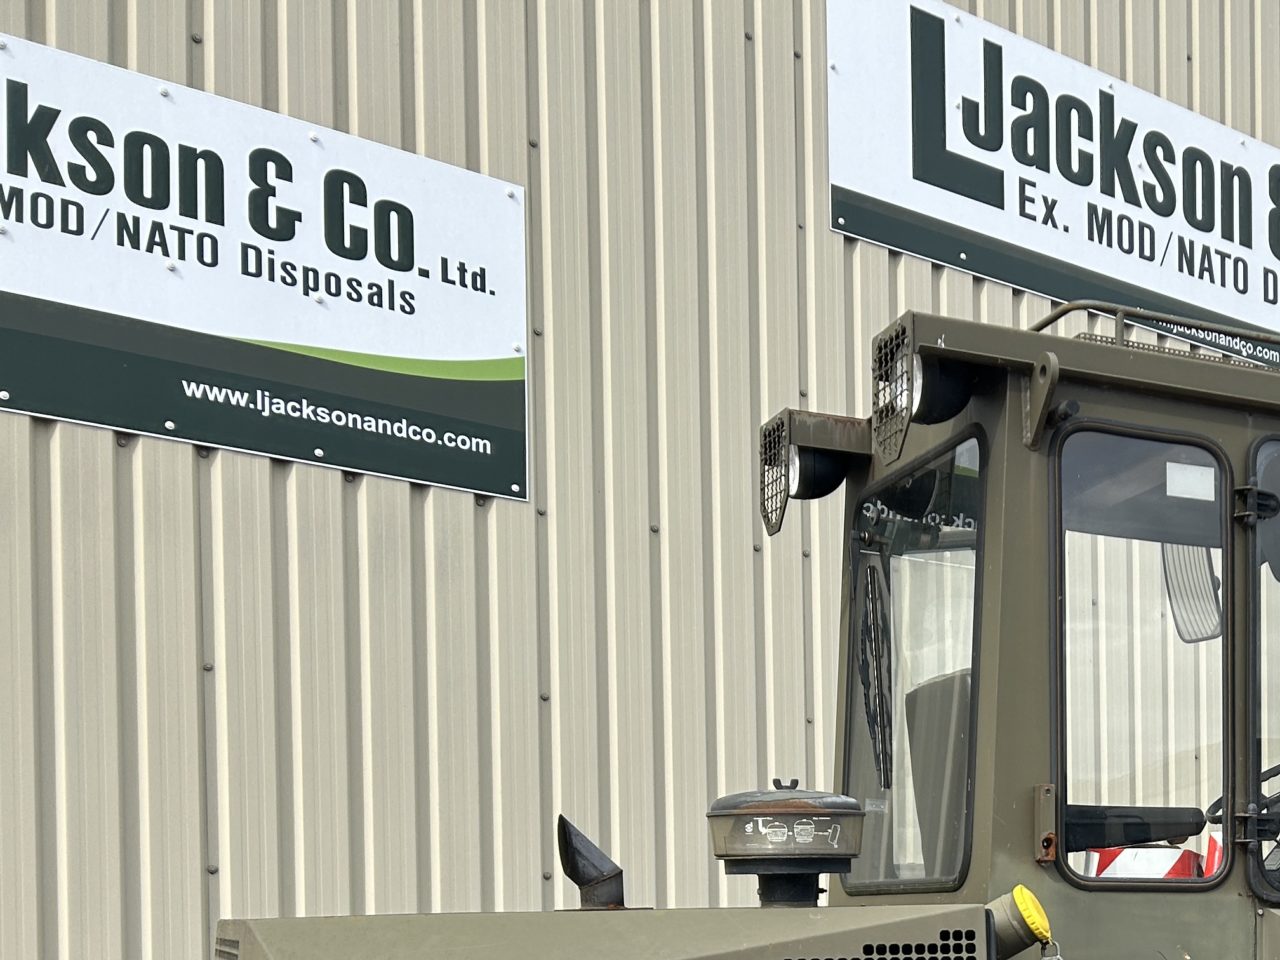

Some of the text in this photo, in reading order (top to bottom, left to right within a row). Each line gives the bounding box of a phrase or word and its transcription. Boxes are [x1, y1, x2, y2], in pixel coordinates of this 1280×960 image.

[249, 147, 302, 241] &
[324, 170, 430, 279] Co.
[441, 256, 496, 296] Ltd.
[1019, 177, 1069, 233] Ex.
[1088, 202, 1249, 295] MOD/NATO
[241, 242, 416, 315] Disposals
[182, 379, 491, 455] www.ljacksonandco.com
